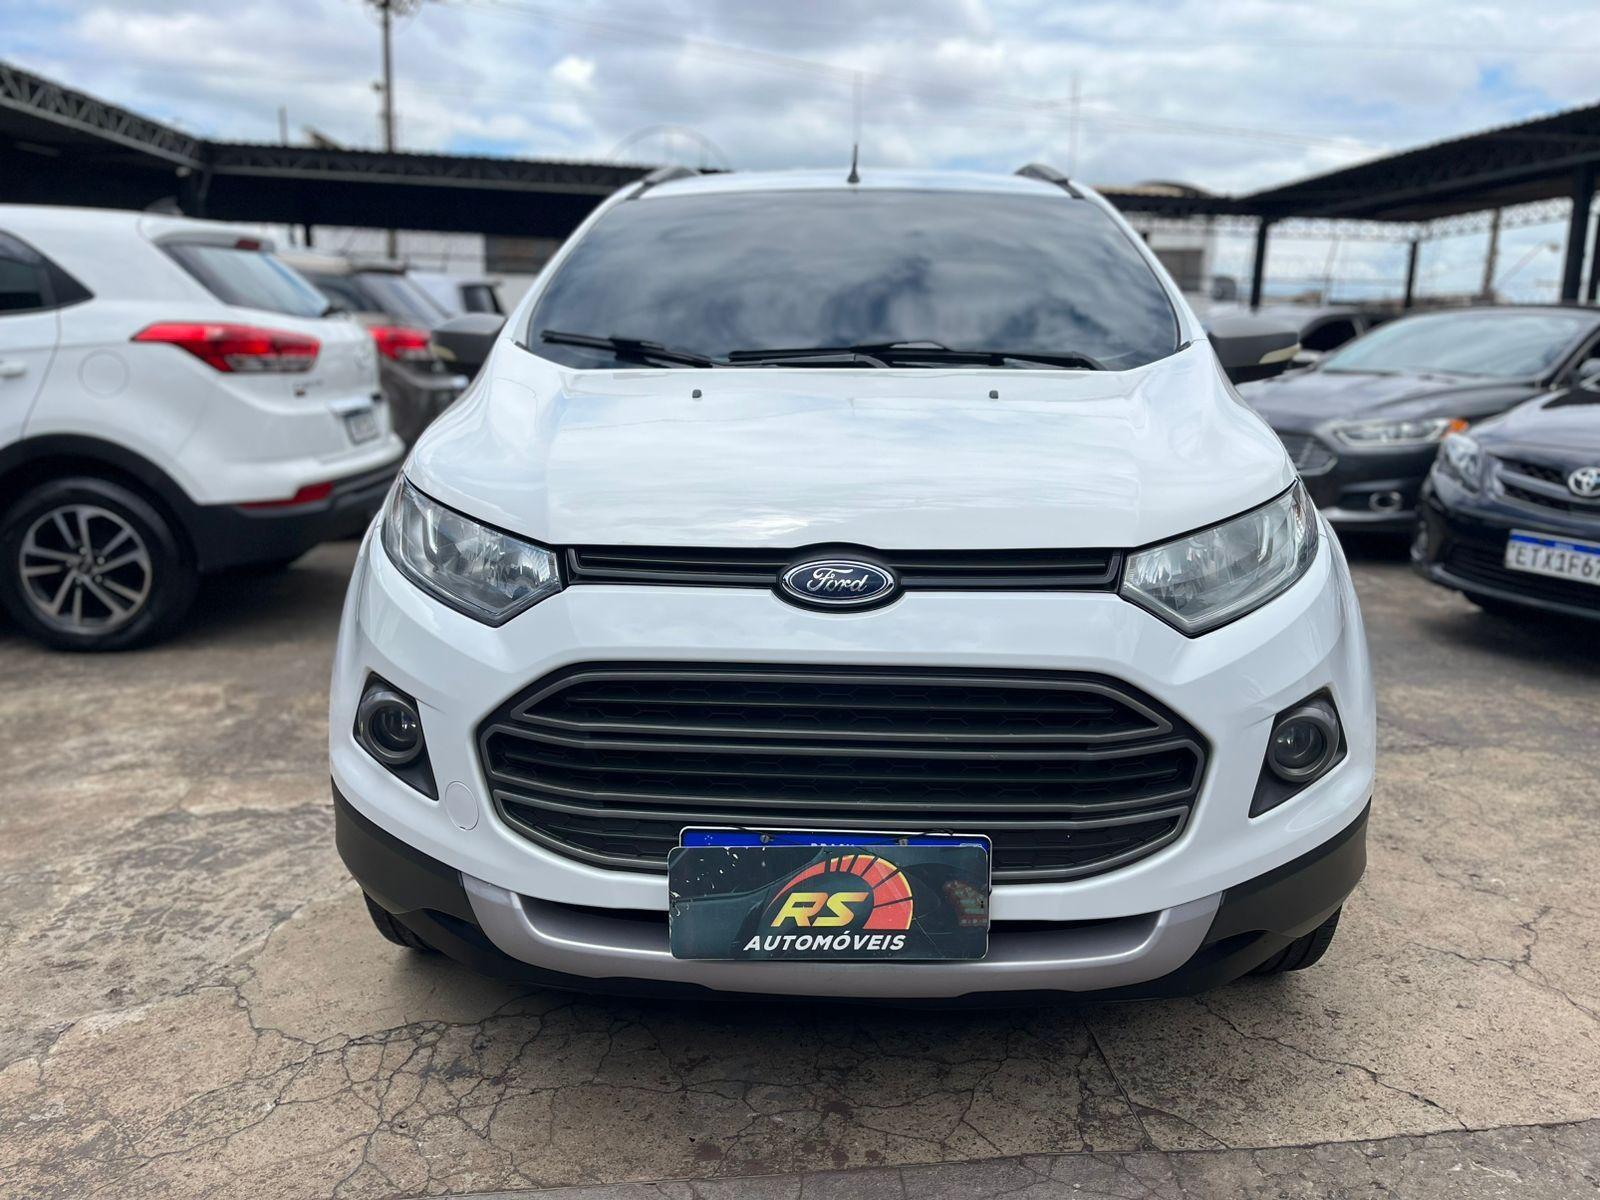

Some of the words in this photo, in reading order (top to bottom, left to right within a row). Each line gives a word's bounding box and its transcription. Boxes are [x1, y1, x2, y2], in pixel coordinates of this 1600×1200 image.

[806, 567, 869, 592] Ford
[770, 892, 869, 927] RS
[743, 930, 906, 951] AUTOMÓVEIS
